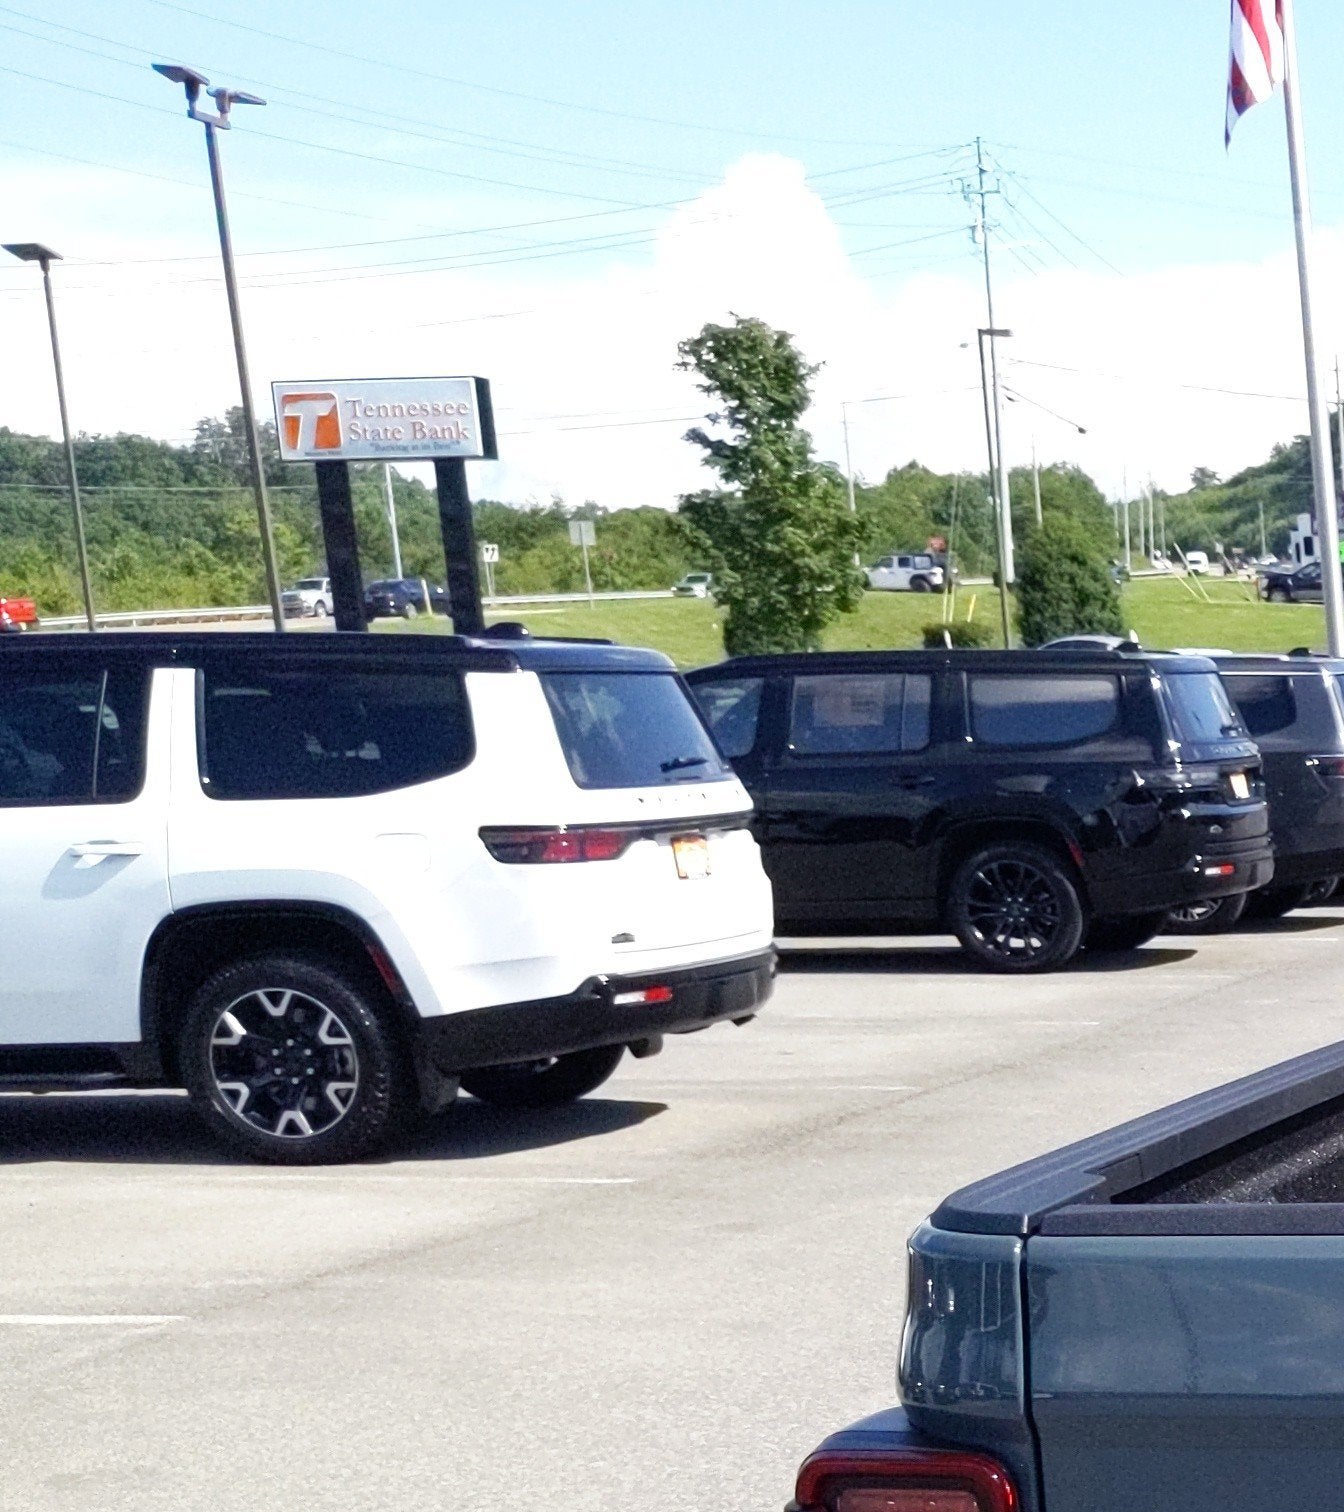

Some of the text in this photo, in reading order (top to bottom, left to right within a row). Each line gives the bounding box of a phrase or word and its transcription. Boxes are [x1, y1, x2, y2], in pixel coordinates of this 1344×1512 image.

[345, 397, 470, 419] Tennessee
[349, 419, 471, 442] State Bank
